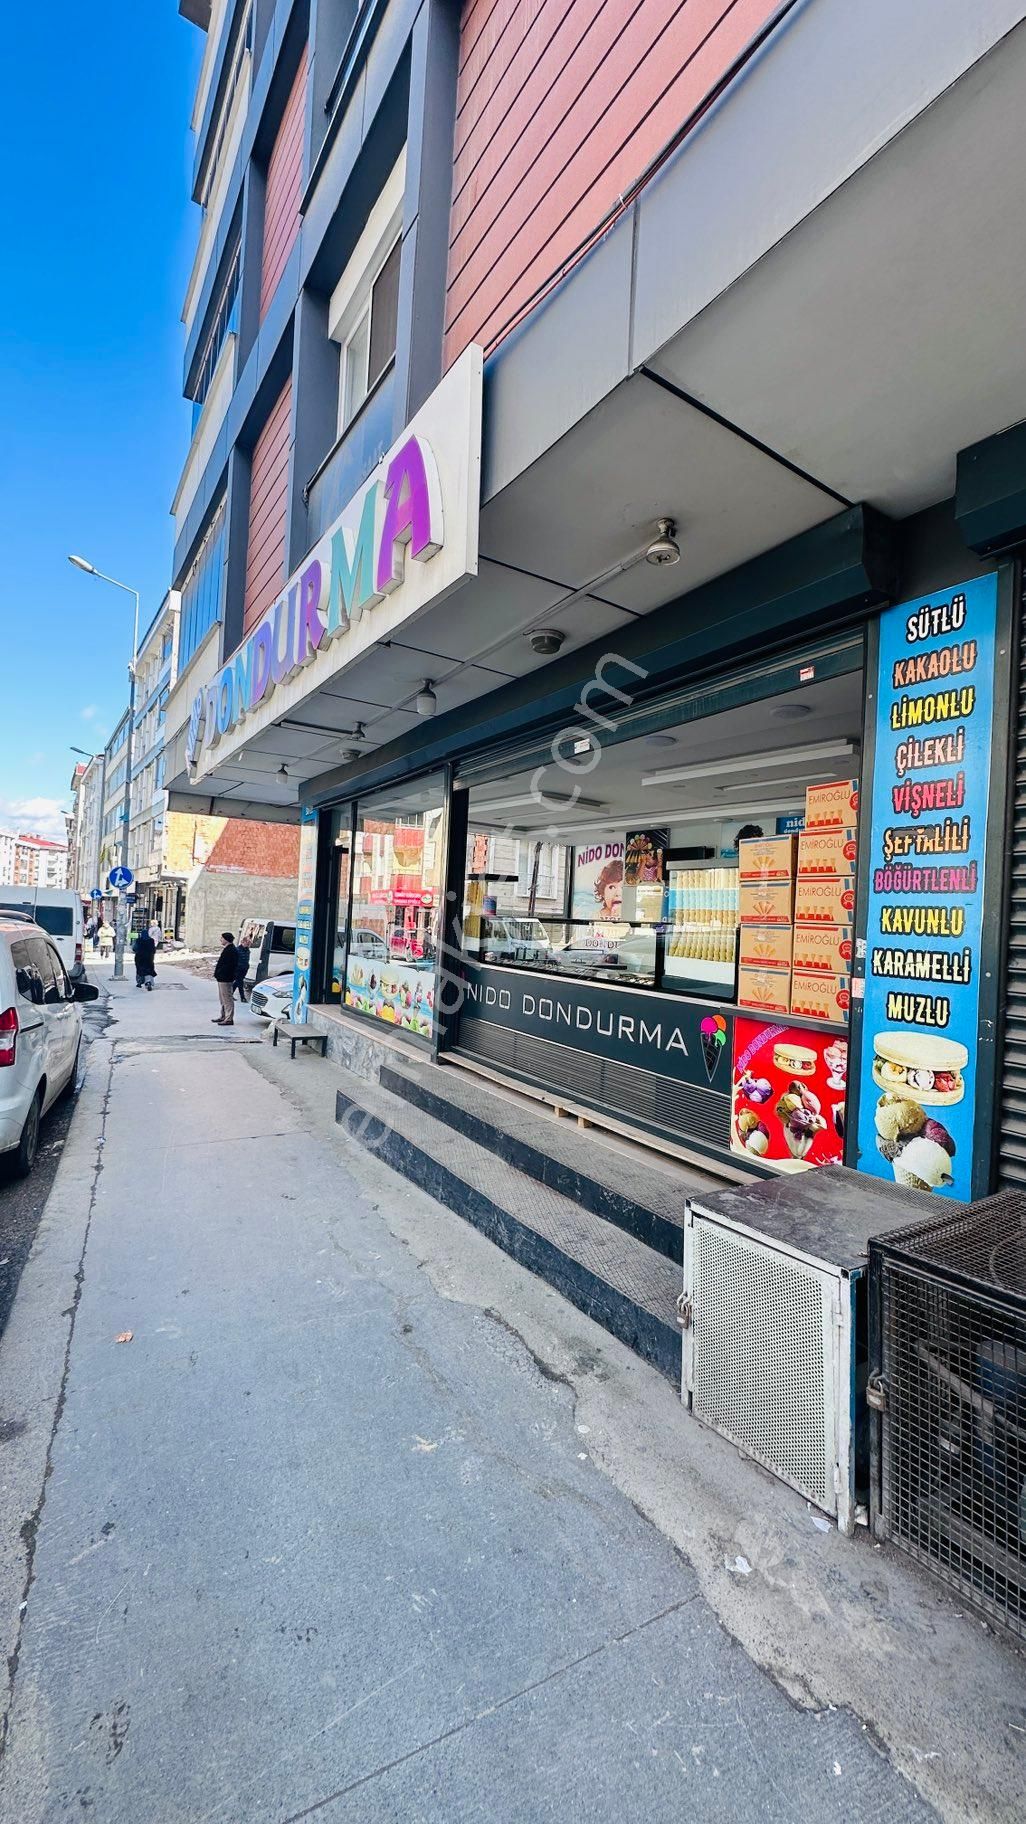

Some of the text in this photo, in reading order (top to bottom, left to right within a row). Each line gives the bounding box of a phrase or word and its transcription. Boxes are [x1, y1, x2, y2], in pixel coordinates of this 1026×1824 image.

[204, 434, 441, 749] DONDURMA
[906, 594, 966, 643] SÜTLÜ
[893, 641, 977, 688] KAKAOLU
[891, 687, 975, 730] LİMONLU
[896, 727, 965, 776] ÇİLEKLİ
[892, 772, 965, 818] VİŞNELİ
[577, 846, 602, 868] NİDO
[874, 860, 978, 894] BÖĞÜRTLENLİ
[881, 906, 964, 937] KAVUNLU
[872, 947, 972, 985] KARAMELLİ
[466, 982, 690, 1057] NIDO DONDURMA
[887, 992, 950, 1029] MUZLU
